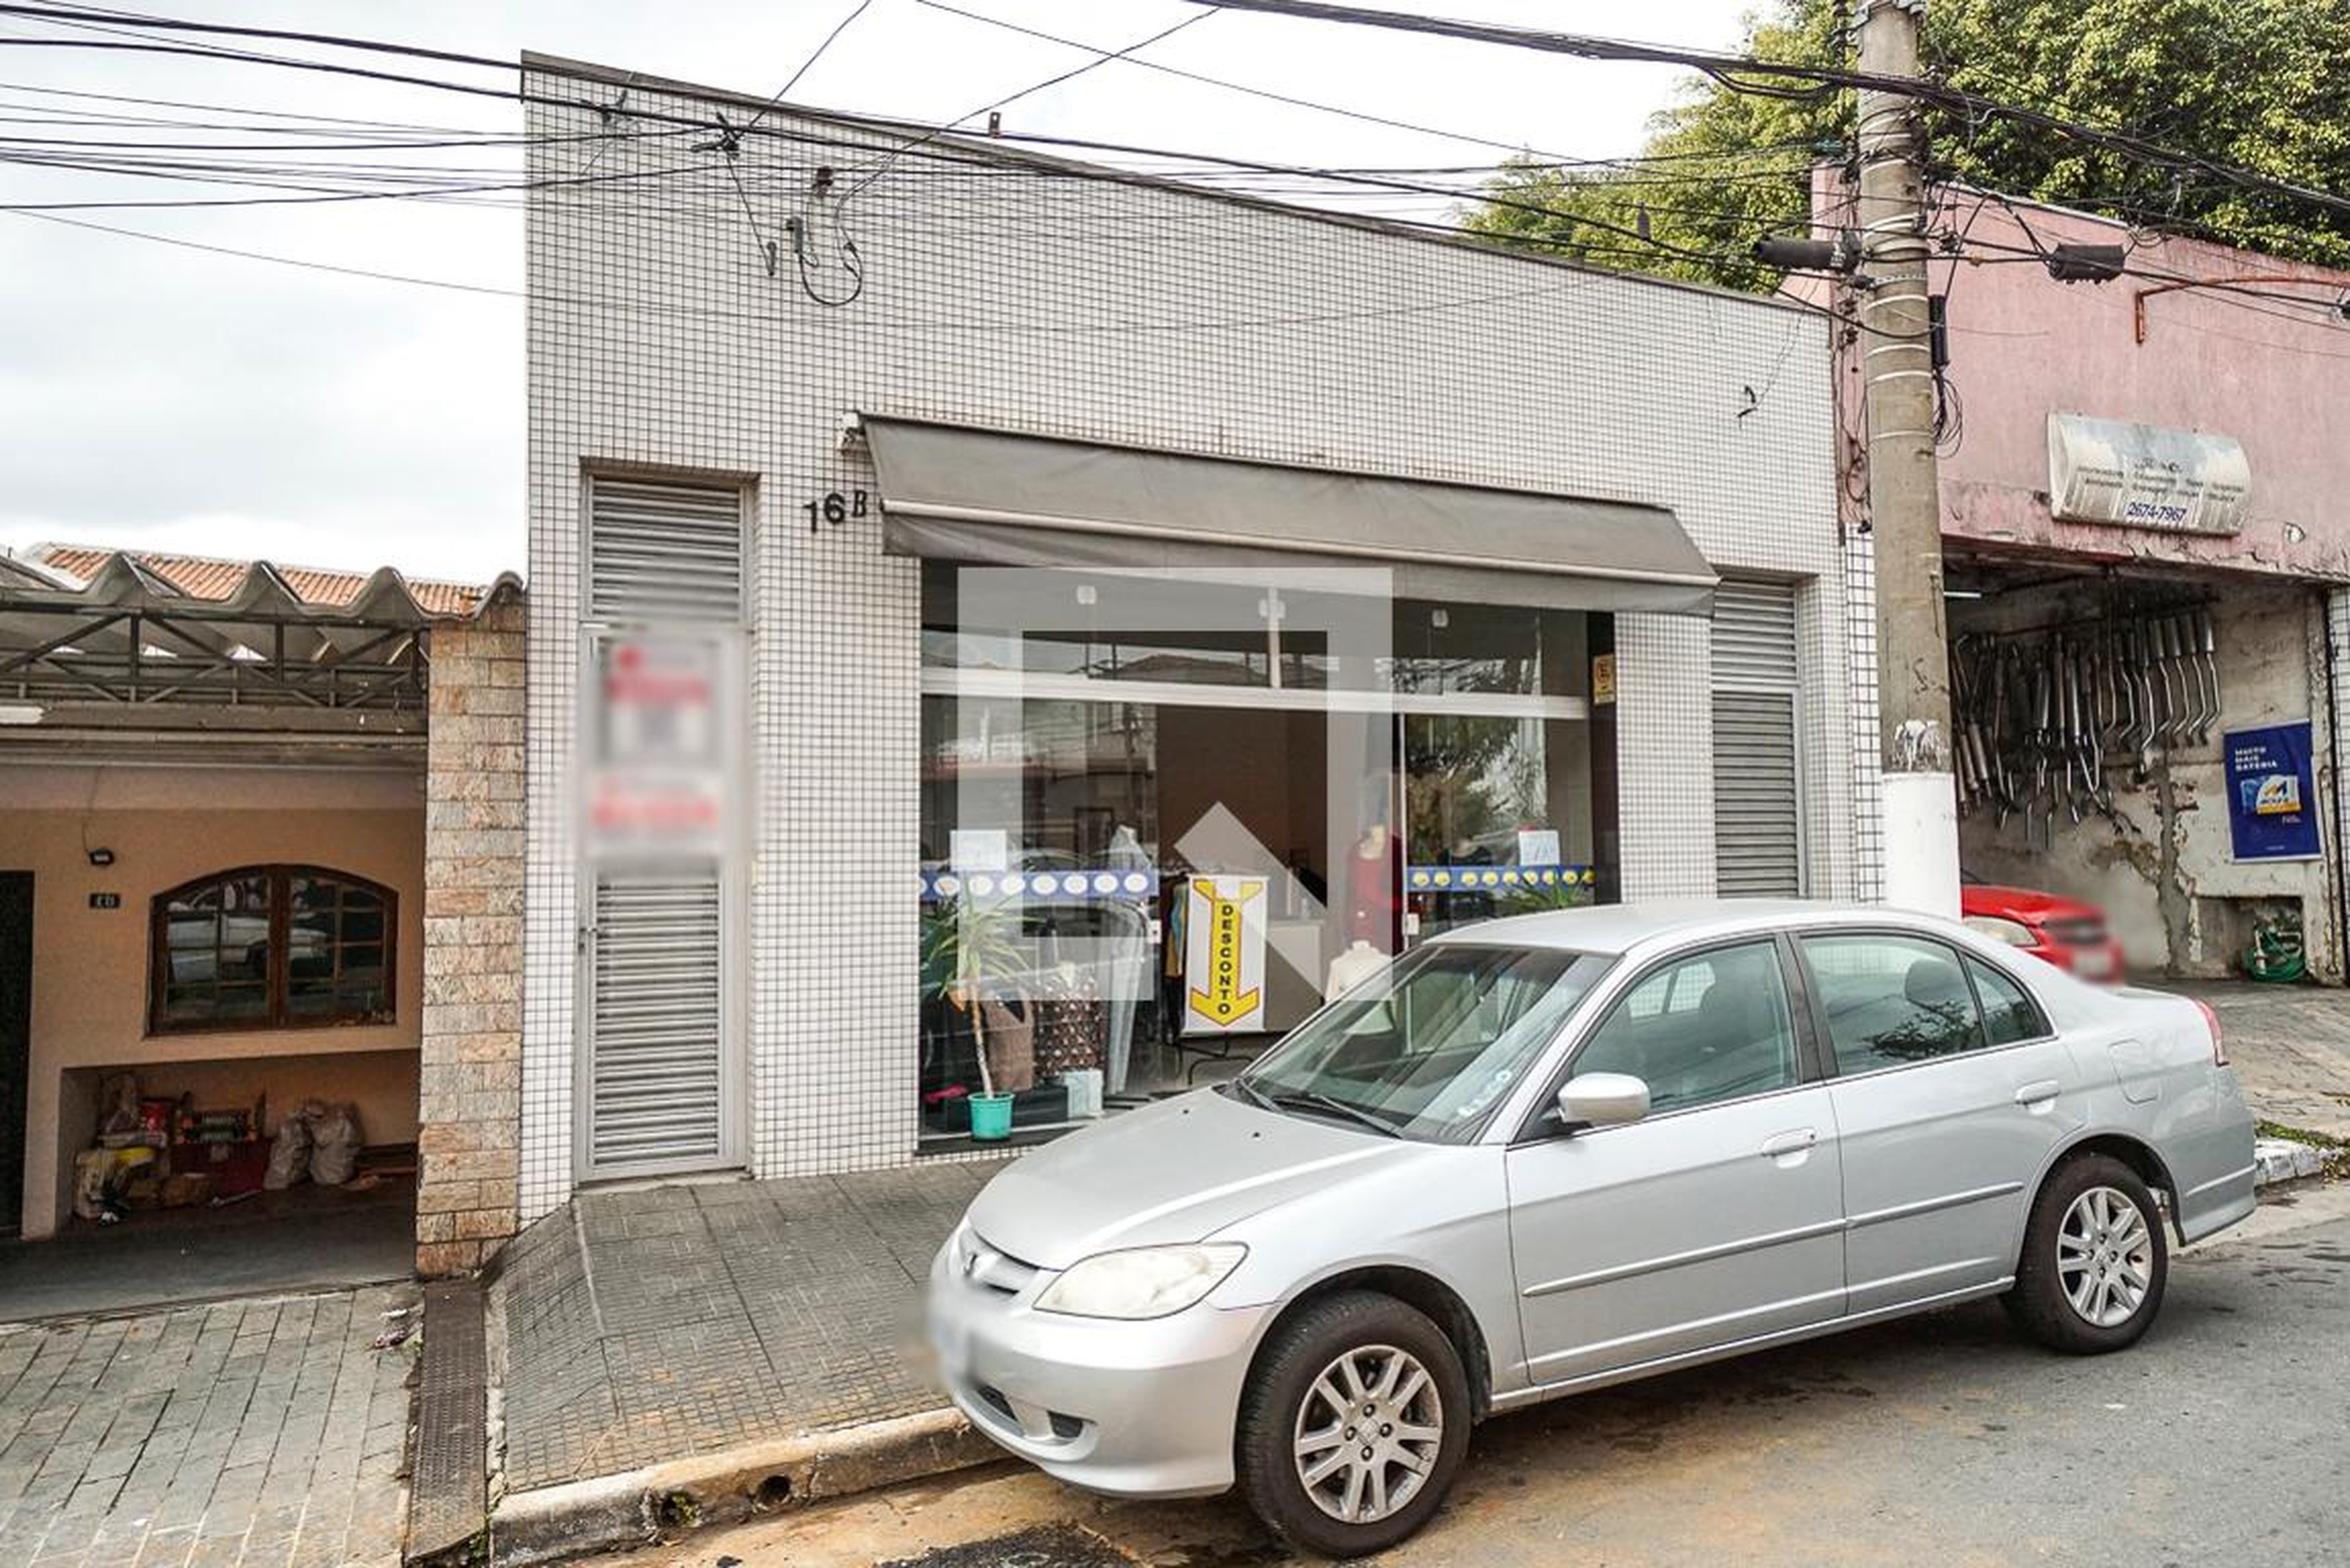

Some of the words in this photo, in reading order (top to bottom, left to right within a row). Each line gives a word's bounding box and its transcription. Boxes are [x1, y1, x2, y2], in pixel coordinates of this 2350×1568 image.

[802, 490, 867, 533] 16B
[2127, 501, 2187, 522] 2674-7967
[1218, 905, 1233, 1014] DESCONTO
